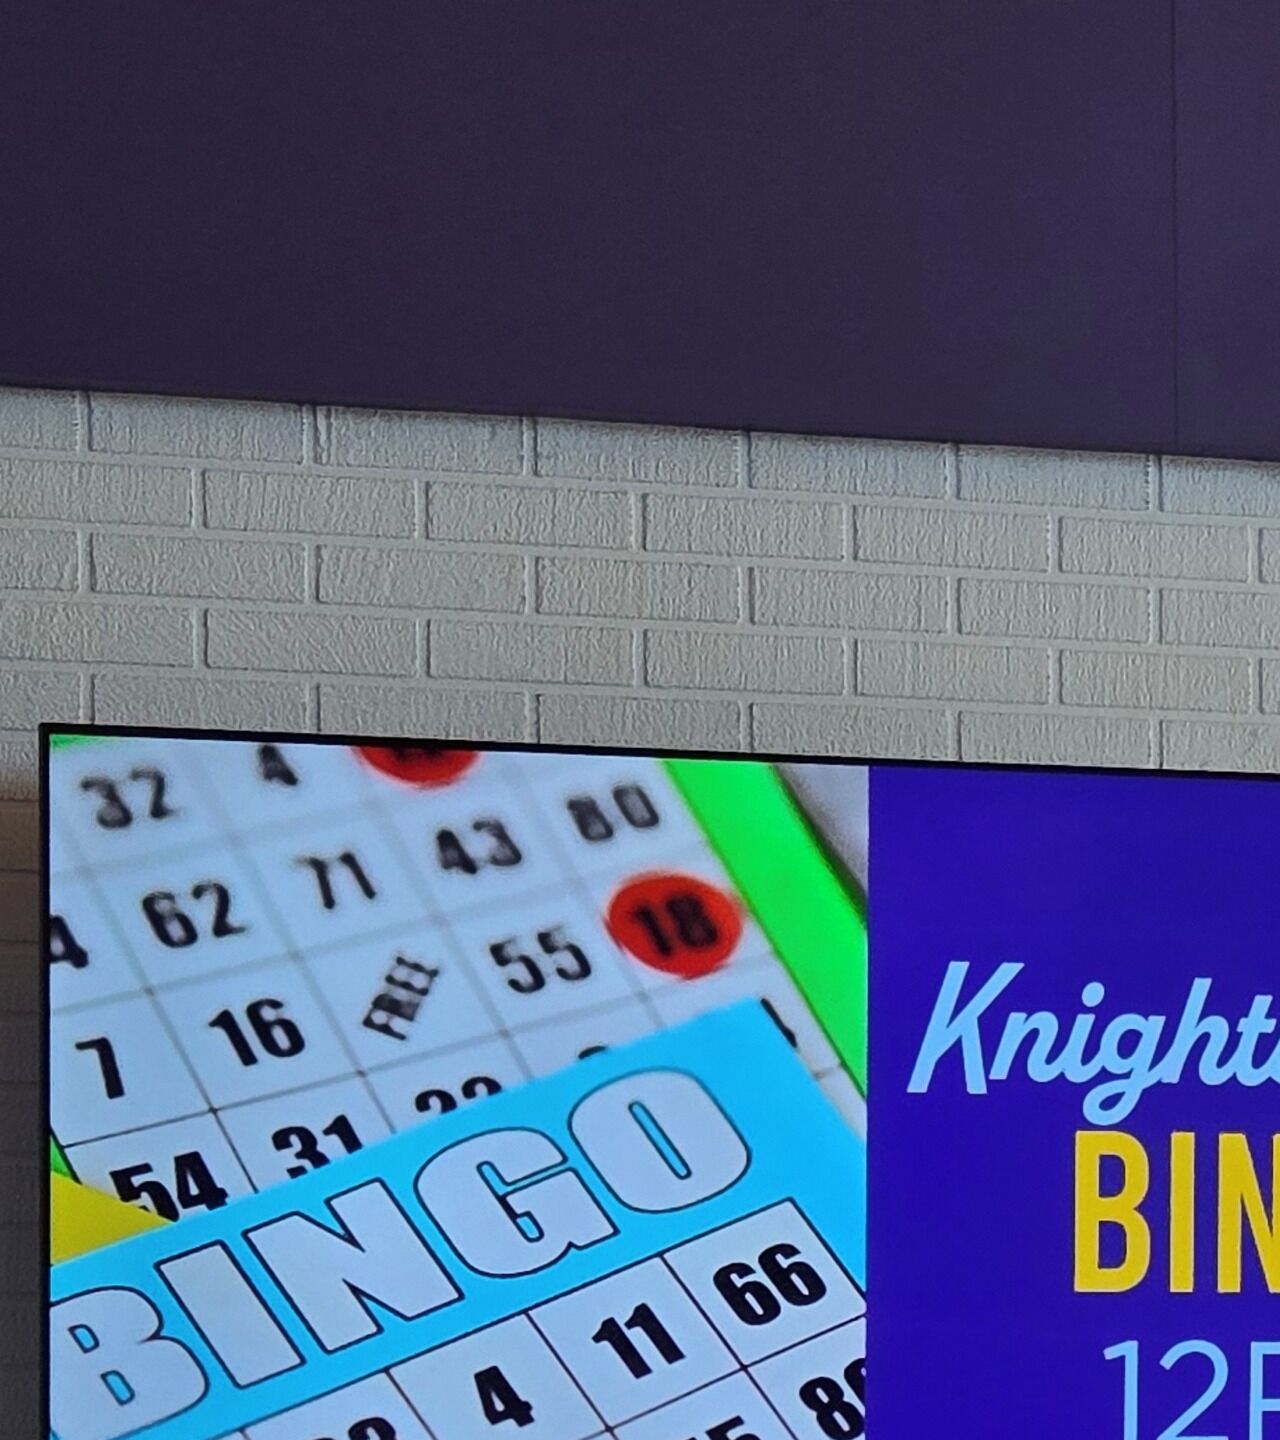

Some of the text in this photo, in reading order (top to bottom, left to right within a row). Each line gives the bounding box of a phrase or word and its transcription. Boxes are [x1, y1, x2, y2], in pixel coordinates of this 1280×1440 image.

[80, 765, 175, 829] 32
[141, 883, 245, 948] 62
[296, 851, 378, 910] 71
[436, 818, 522, 875] 43
[75, 1037, 126, 1100] 7
[208, 998, 305, 1067] 16
[488, 926, 592, 993] 55
[634, 891, 719, 957] 18
[109, 1114, 364, 1223] 54 31
[474, 1365, 536, 1428] 4
[591, 1302, 687, 1380] 11
[712, 1242, 827, 1326] 66
